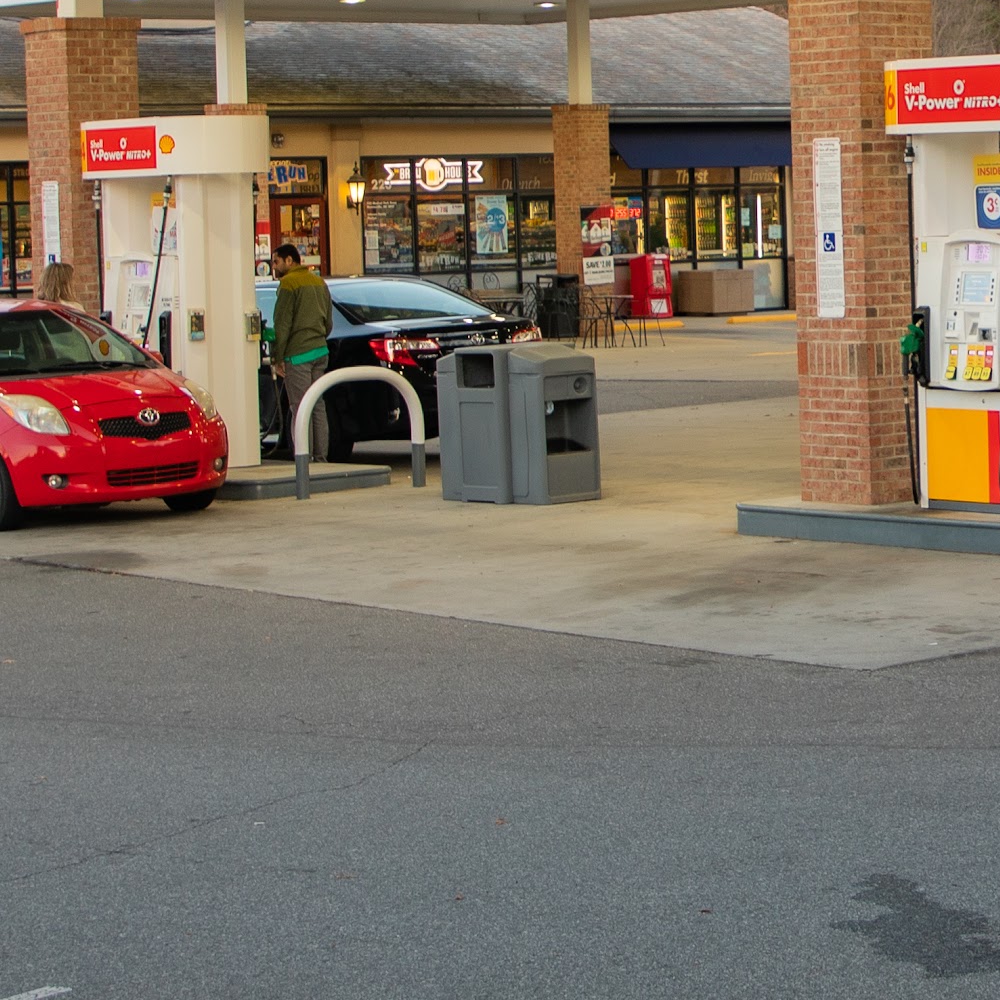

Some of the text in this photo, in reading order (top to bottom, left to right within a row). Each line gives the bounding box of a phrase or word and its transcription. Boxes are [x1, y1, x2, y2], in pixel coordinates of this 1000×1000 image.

[904, 82, 925, 94] Shell
[904, 95, 961, 111] V-Power
[90, 139, 104, 149] Shell
[90, 150, 125, 162] V-Power
[586, 261, 600, 269] SAVE
